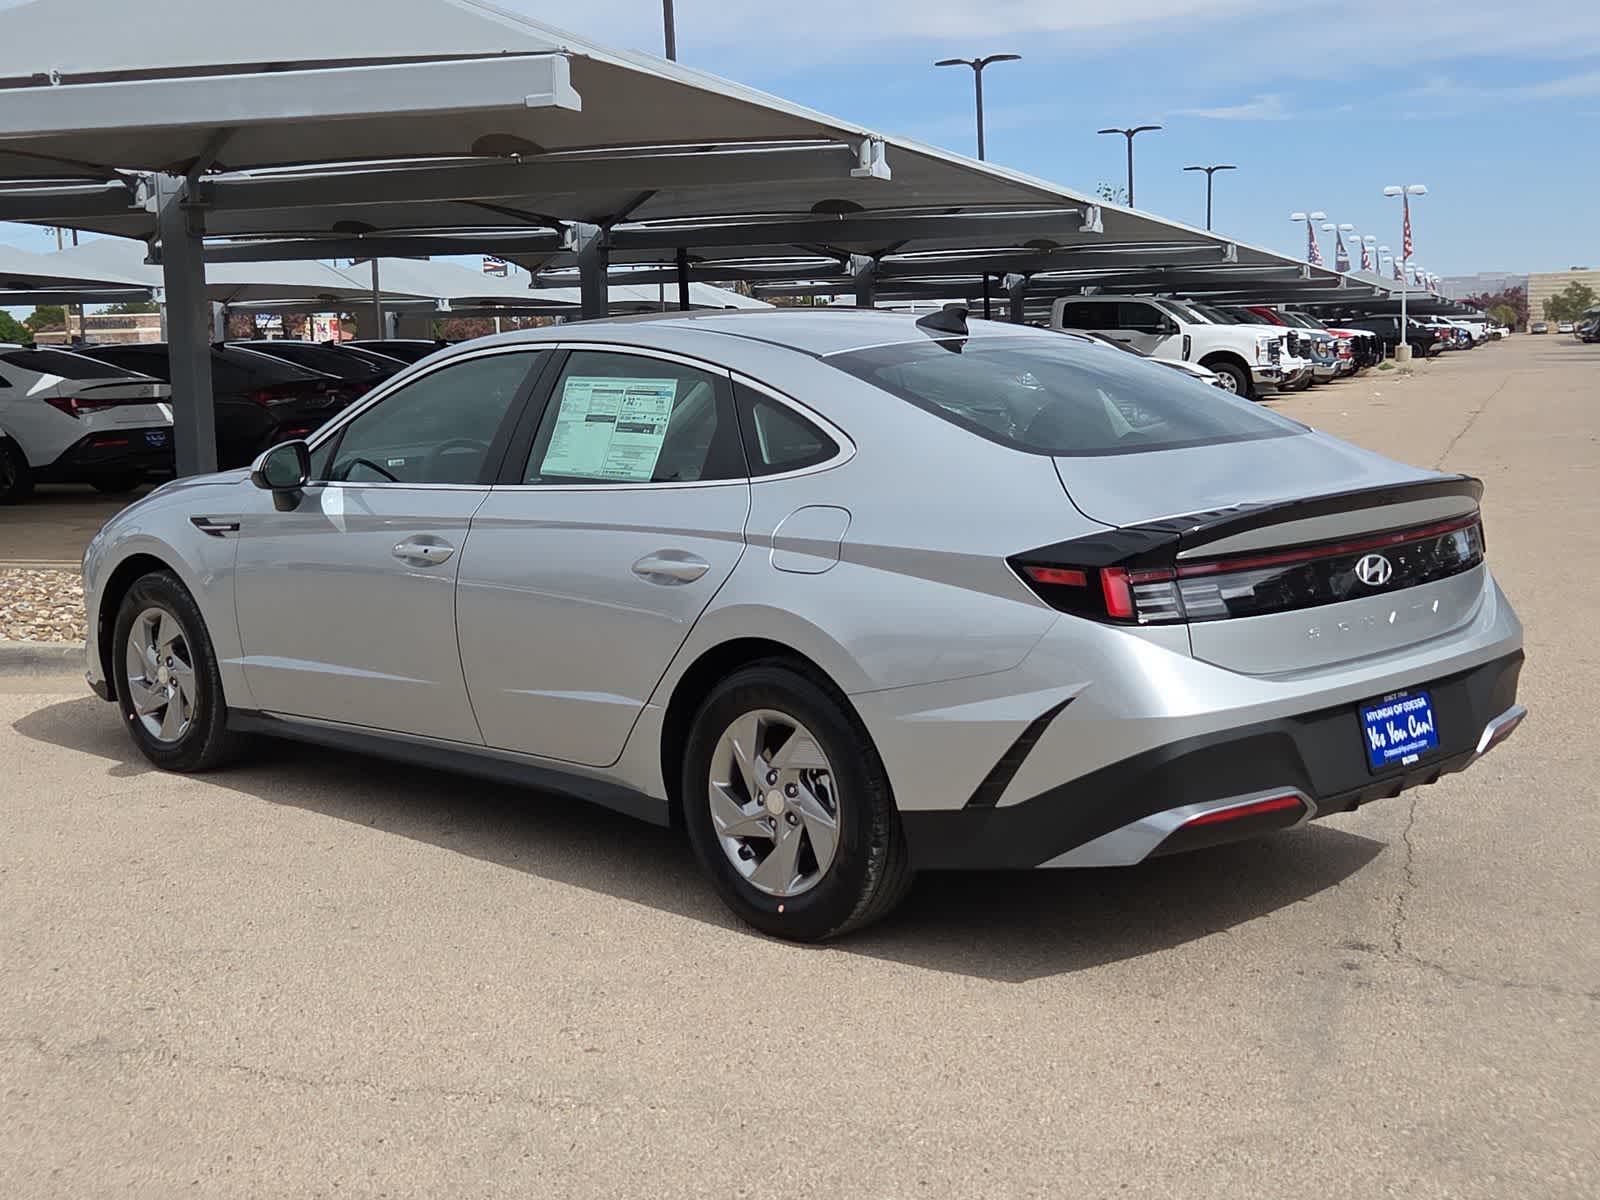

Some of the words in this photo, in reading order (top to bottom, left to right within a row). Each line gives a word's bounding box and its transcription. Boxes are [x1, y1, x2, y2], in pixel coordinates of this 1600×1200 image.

[1394, 703, 1403, 715] OF
[1367, 725, 1386, 750] Yes
[1386, 720, 1408, 744] You
[1408, 709, 1433, 738] Can!
